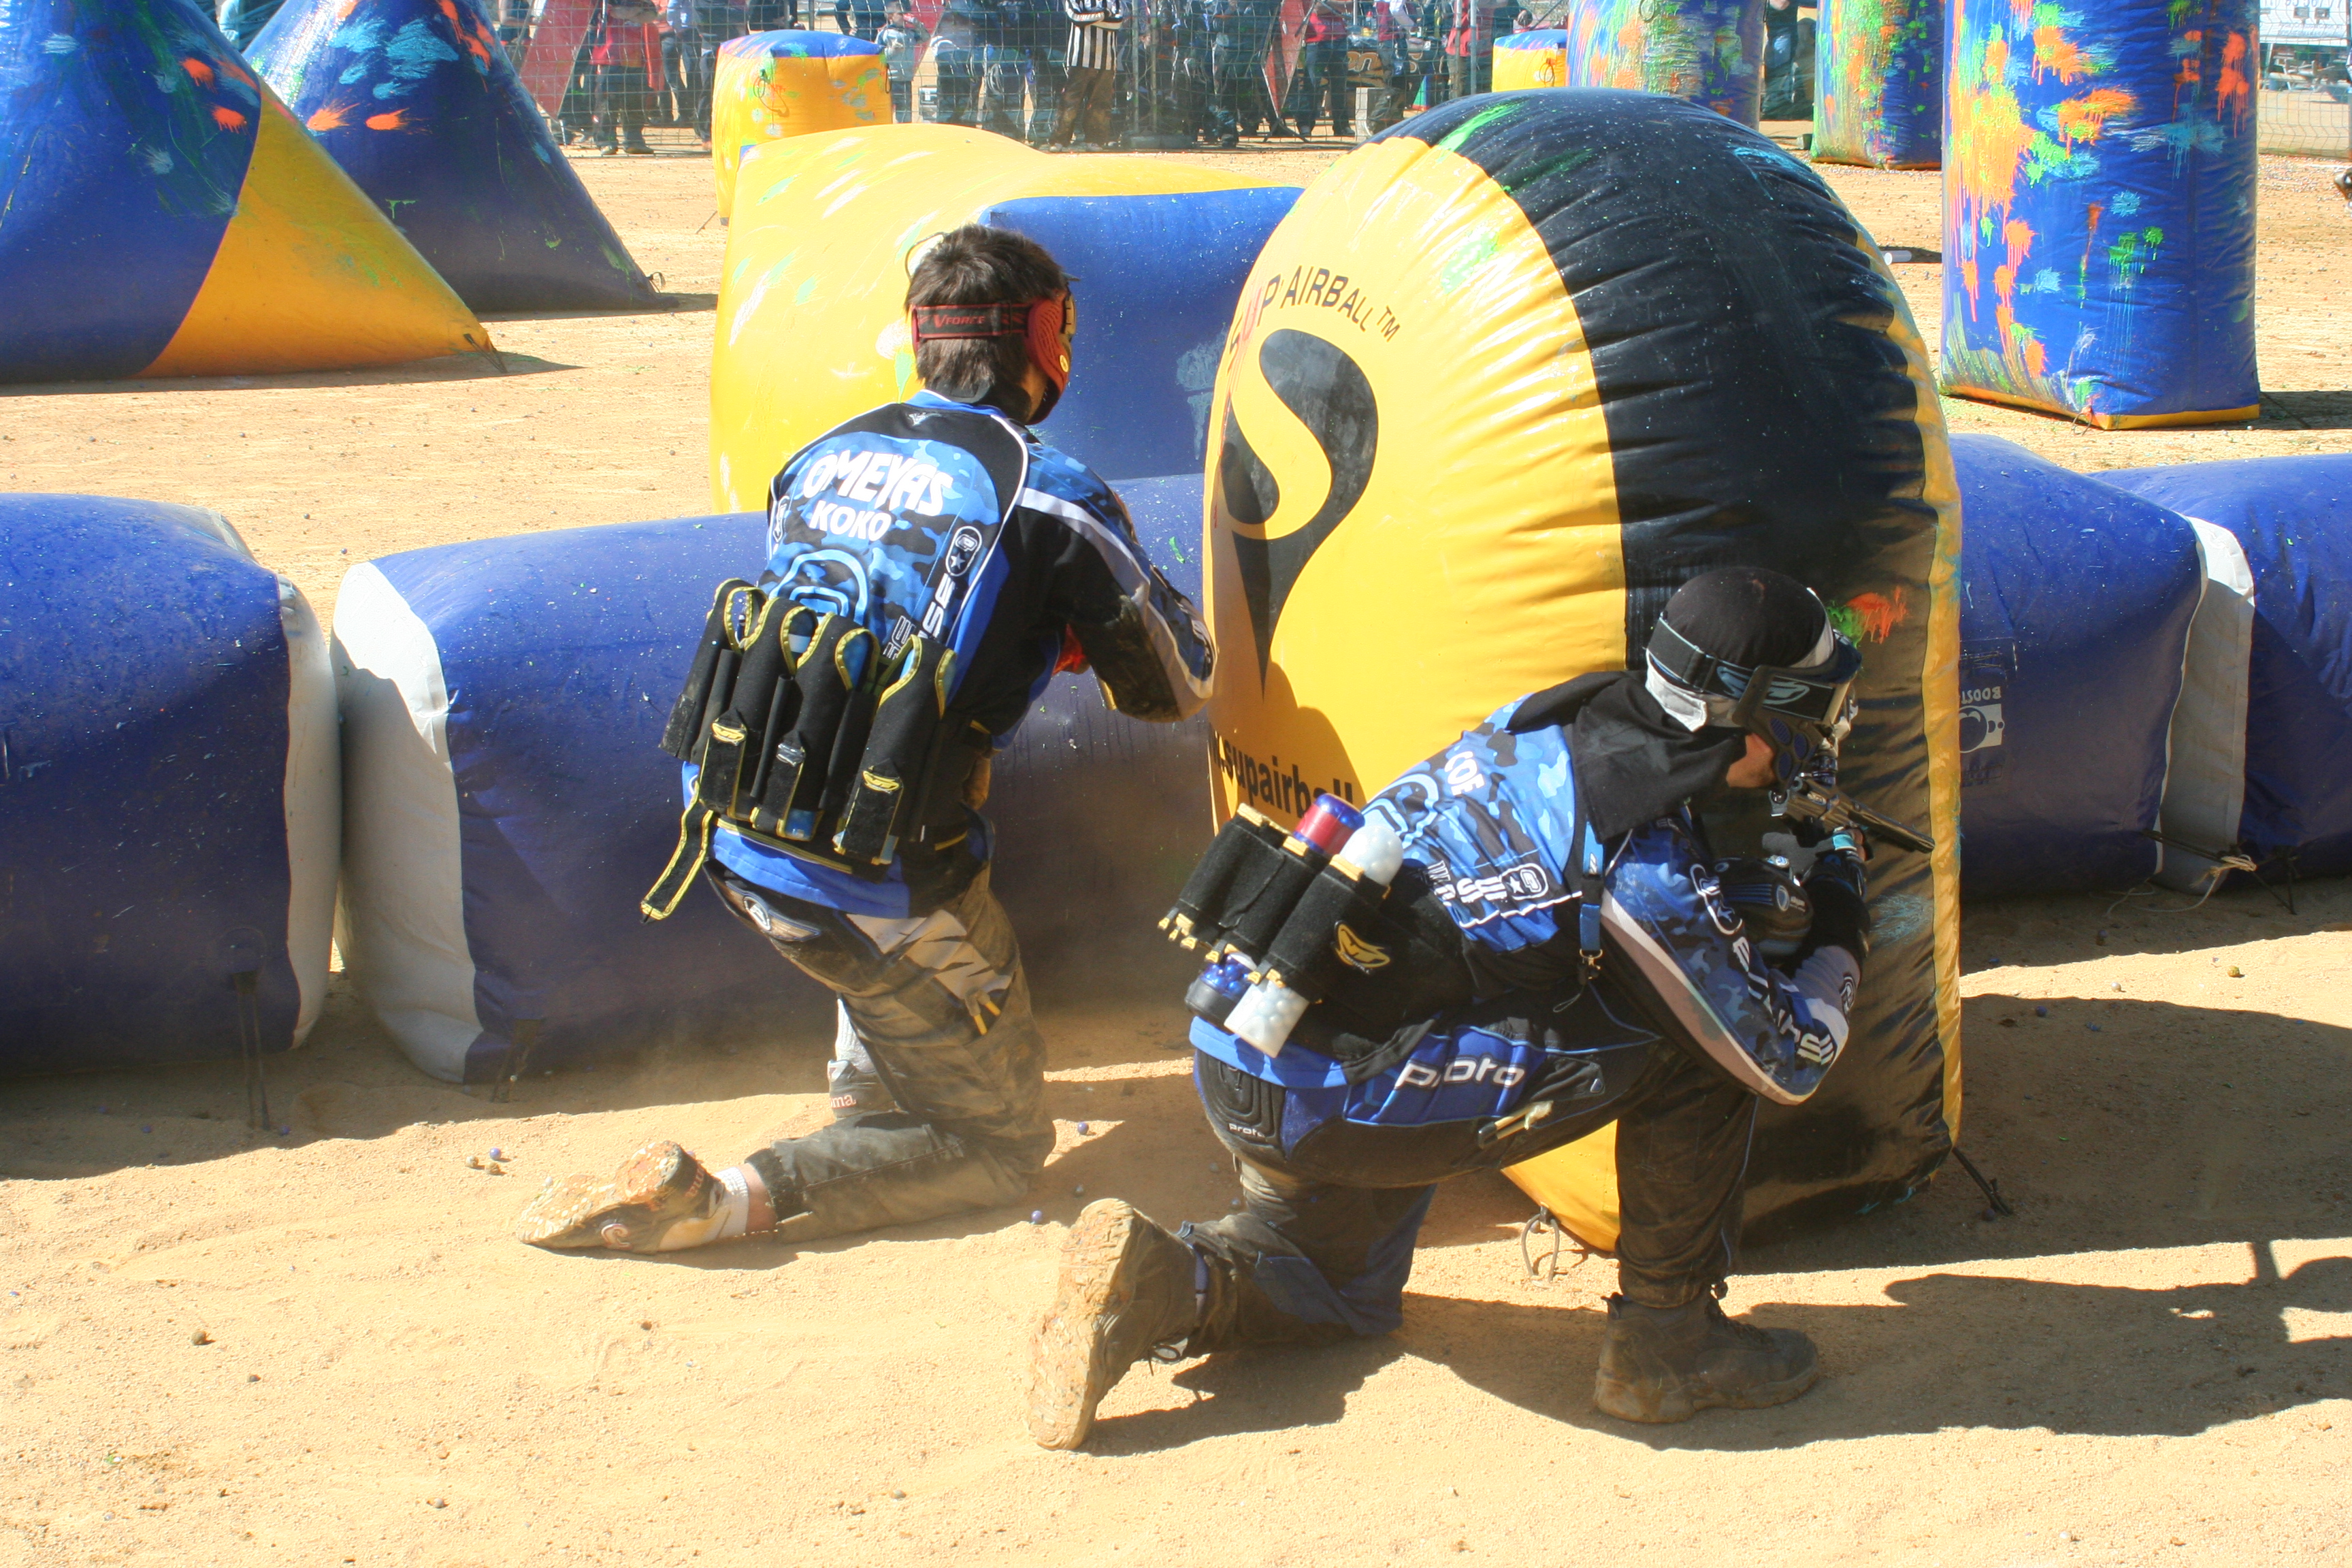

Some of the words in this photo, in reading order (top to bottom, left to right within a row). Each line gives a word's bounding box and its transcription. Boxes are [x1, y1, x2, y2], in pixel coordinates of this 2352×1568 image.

[803, 449, 953, 516] OMEYAS
[810, 500, 892, 541] KOKO
[1395, 1057, 1525, 1088] poto
